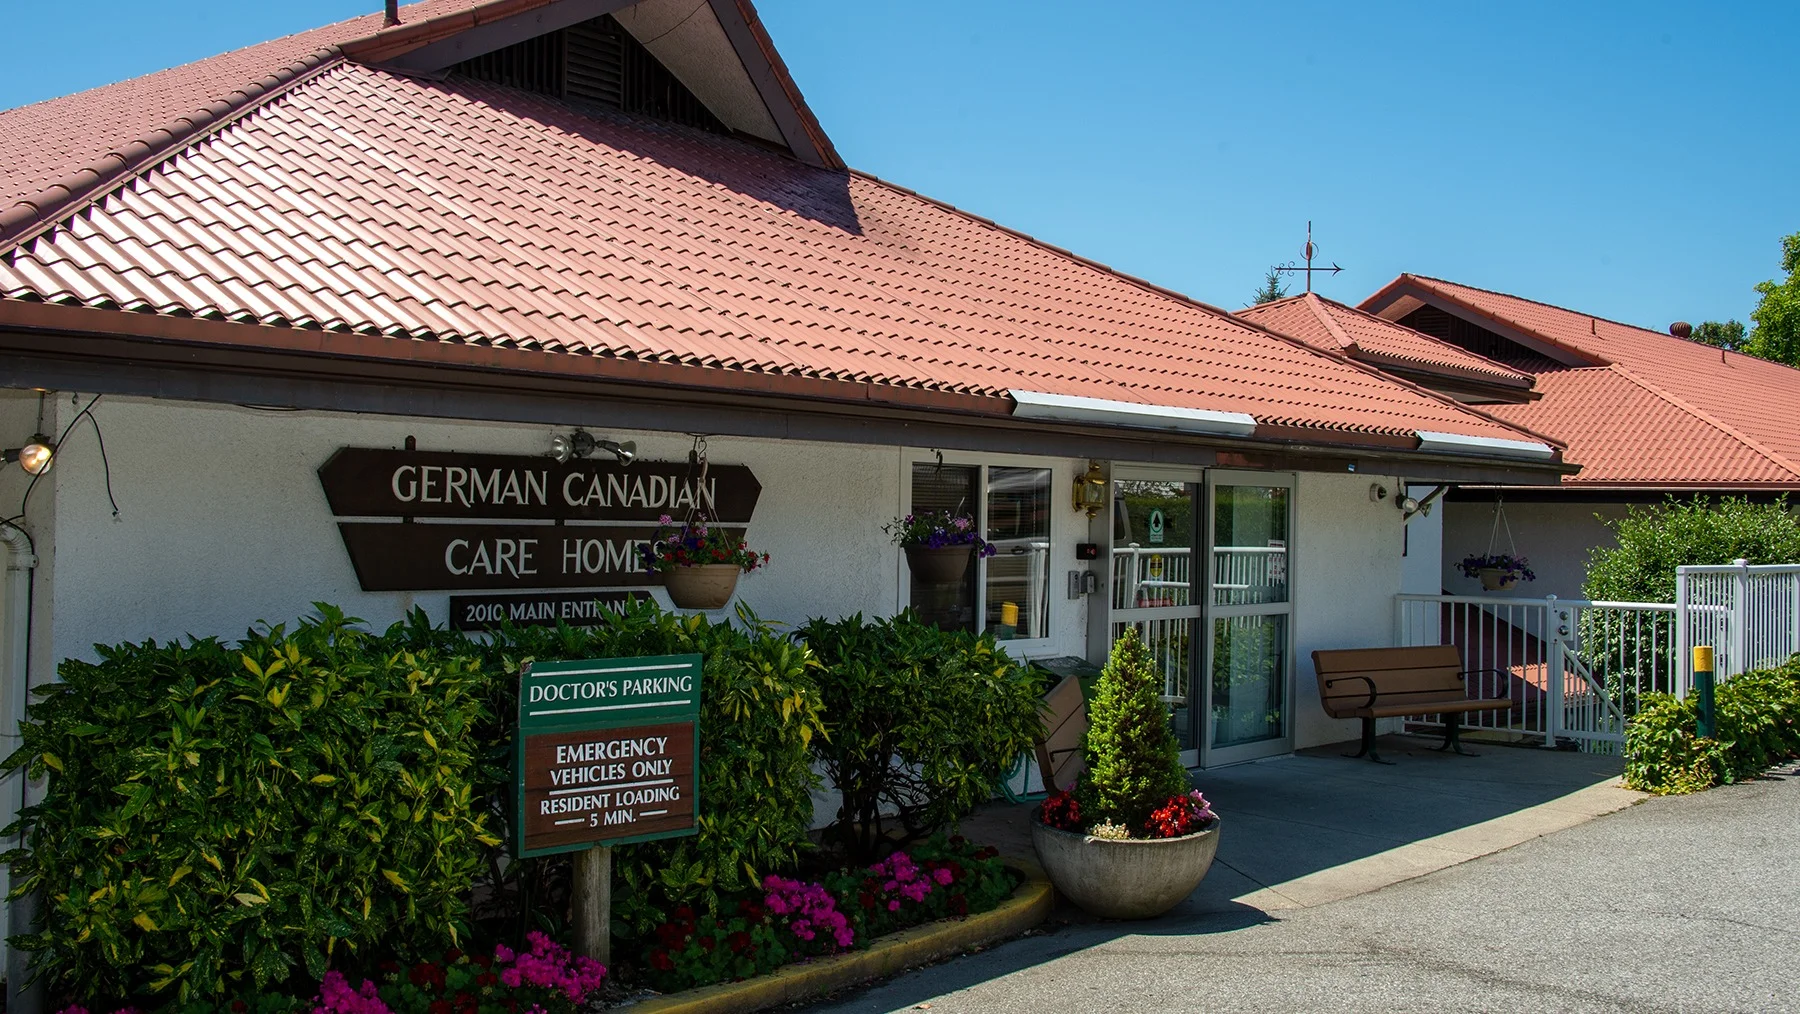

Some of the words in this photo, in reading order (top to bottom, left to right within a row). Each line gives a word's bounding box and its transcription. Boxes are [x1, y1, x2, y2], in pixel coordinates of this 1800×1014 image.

[391, 465, 548, 508] GERMAN
[562, 472, 716, 509] CANADIAN
[445, 538, 538, 579] CARE
[466, 603, 503, 622] 2010
[510, 602, 555, 621] MAIN
[529, 680, 618, 703] DOCTOR'S
[622, 675, 692, 696] PARKING
[556, 736, 668, 764] EMERGENCY
[550, 763, 626, 786] VEHICLES
[632, 759, 673, 777] ONLY
[540, 793, 610, 815] RESIDENT
[615, 786, 680, 806] LOADING
[589, 813, 598, 828] 5
[603, 809, 637, 826] MIN.
